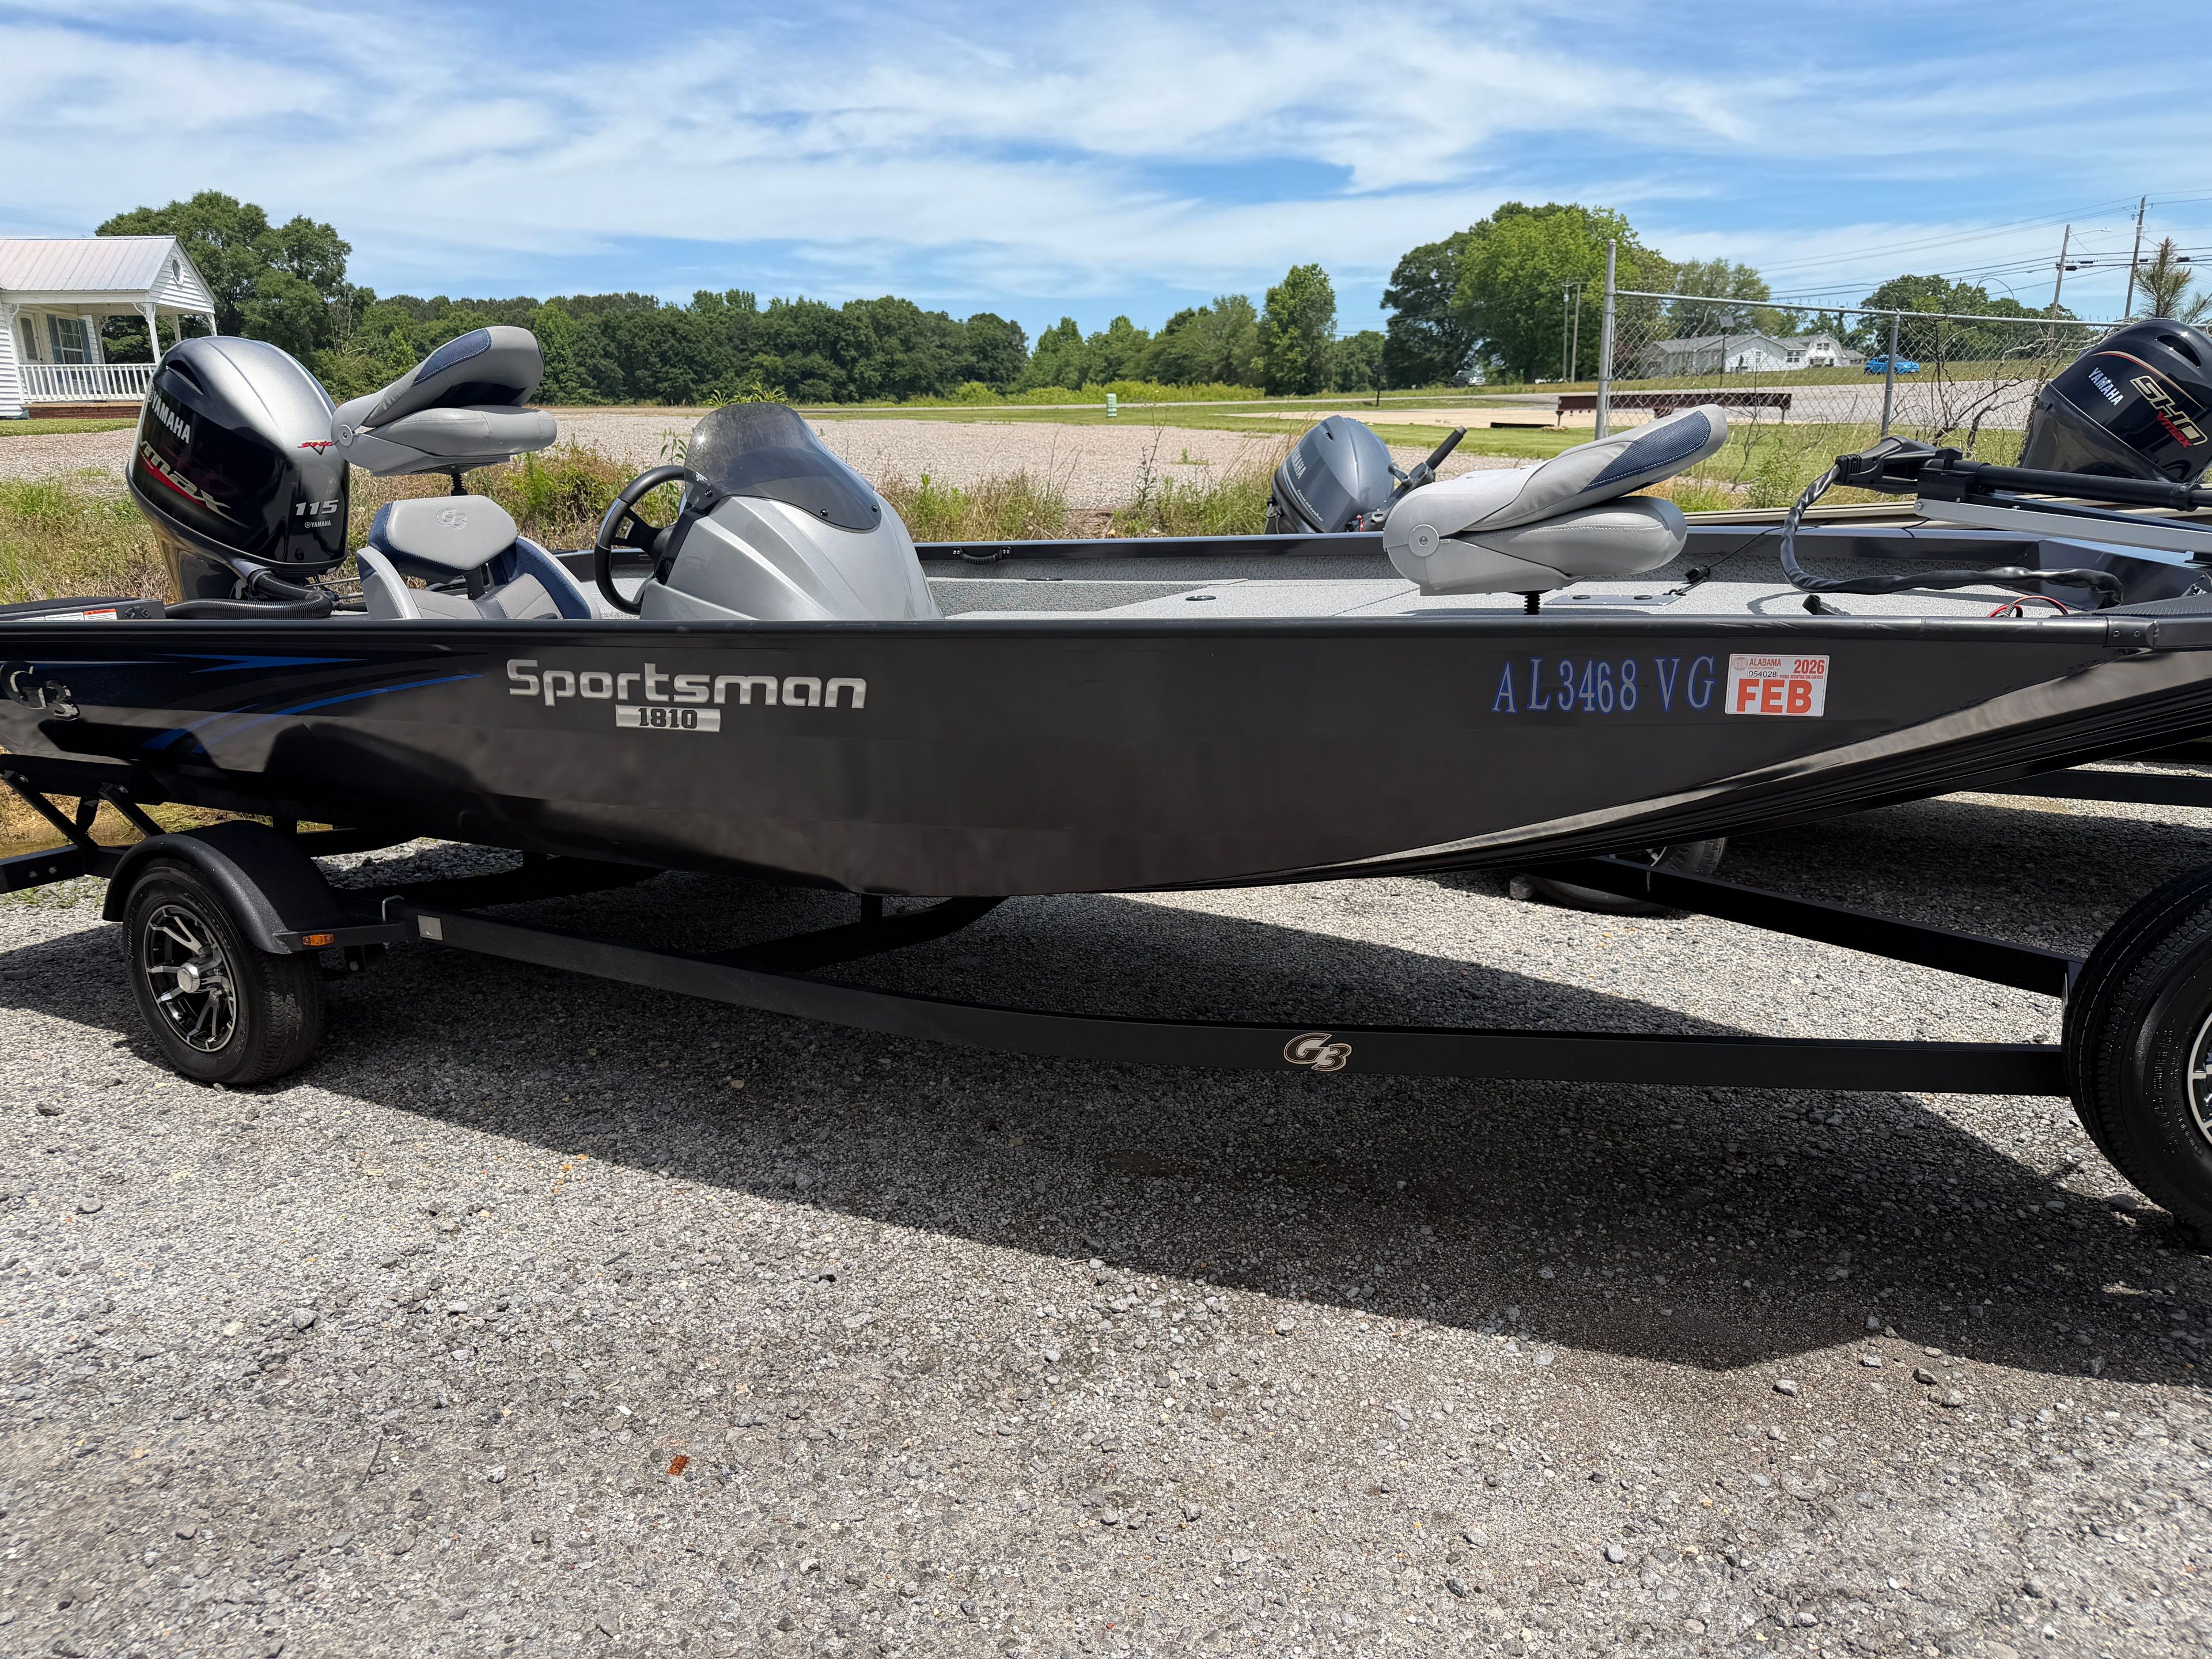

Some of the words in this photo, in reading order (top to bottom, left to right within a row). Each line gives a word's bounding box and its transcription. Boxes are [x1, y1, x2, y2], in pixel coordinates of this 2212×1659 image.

[2088, 367, 2124, 406] YAMAHA
[151, 391, 191, 444] YAMAHA
[296, 499, 339, 516] 115
[437, 507, 467, 529] G3
[506, 659, 868, 709] Sportsman
[1749, 658, 1781, 666] ALABAMA
[1793, 659, 1825, 674] 2026
[1736, 678, 1812, 714] FEB
[638, 707, 698, 729] 1810
[1283, 1032, 1352, 1071] G3
